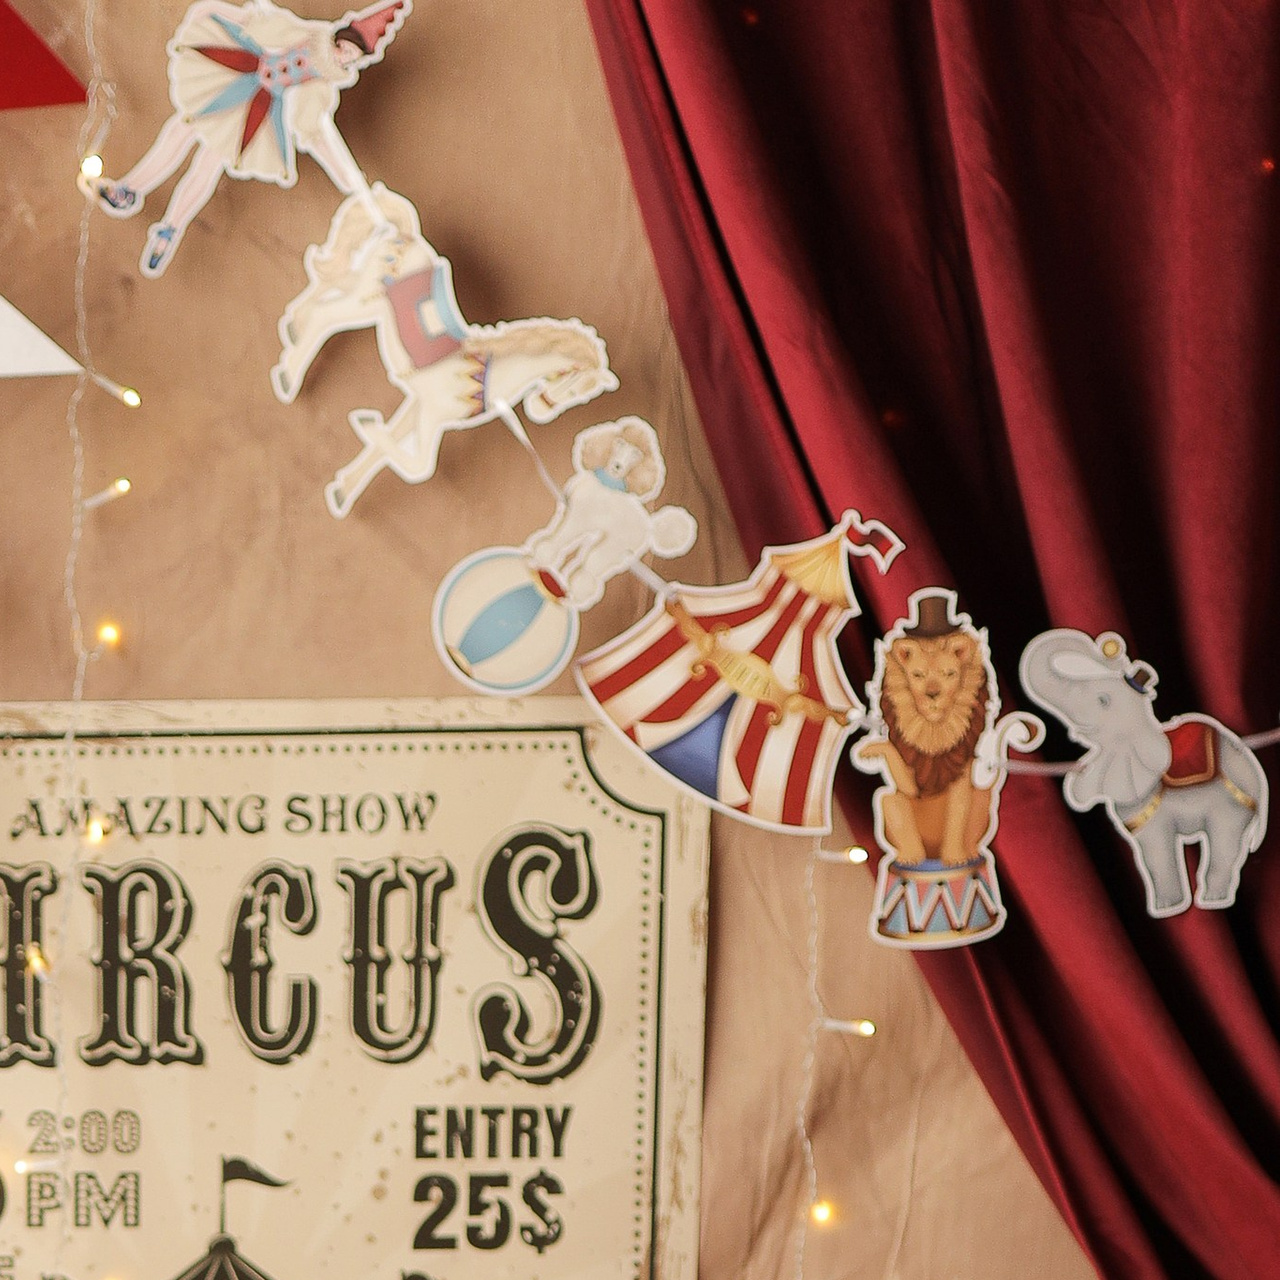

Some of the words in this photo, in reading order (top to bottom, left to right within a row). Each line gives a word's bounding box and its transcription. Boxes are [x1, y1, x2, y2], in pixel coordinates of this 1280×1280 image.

[11, 796, 266, 837] AMAZING
[285, 792, 438, 833] SHOW
[27, 1109, 141, 1154] 2:00
[415, 1106, 572, 1159] ENTRY
[26, 1172, 141, 1228] PM
[412, 1168, 563, 1254] 25$
